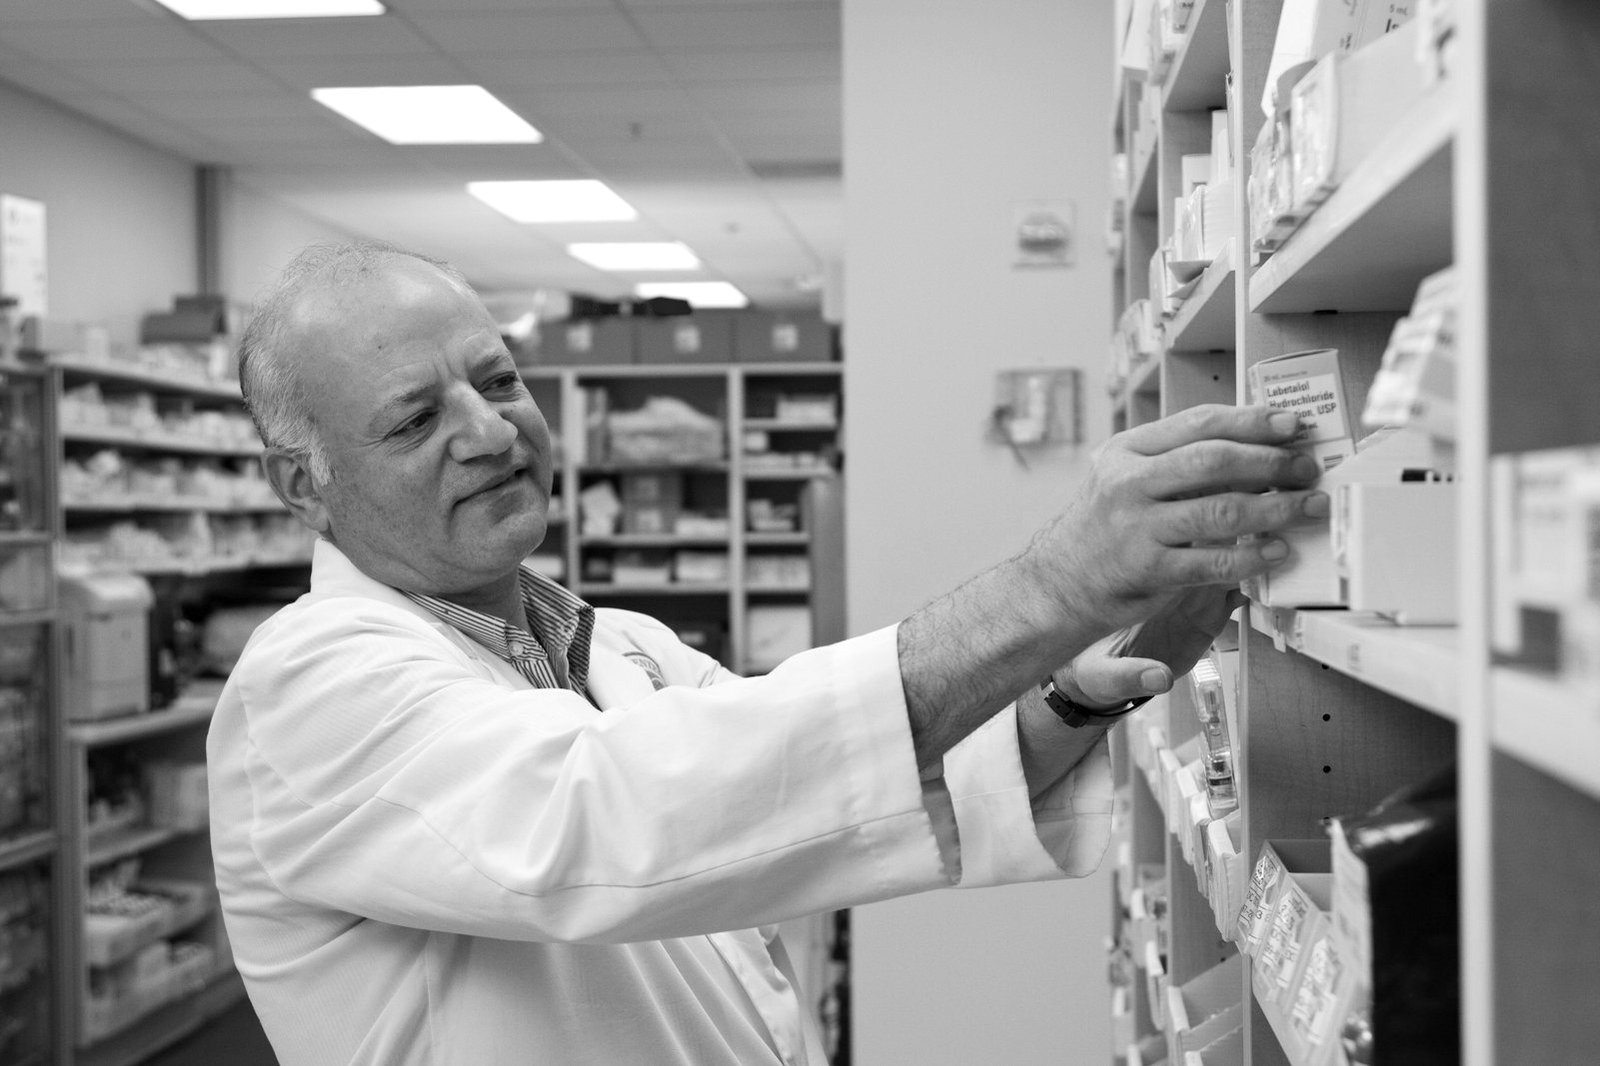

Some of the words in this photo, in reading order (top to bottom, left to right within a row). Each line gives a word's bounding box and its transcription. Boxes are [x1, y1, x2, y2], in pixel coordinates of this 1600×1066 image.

[1267, 381, 1310, 397] Labetalol
[1270, 391, 1334, 408] Hydrochloride
[1317, 402, 1337, 415] USP
